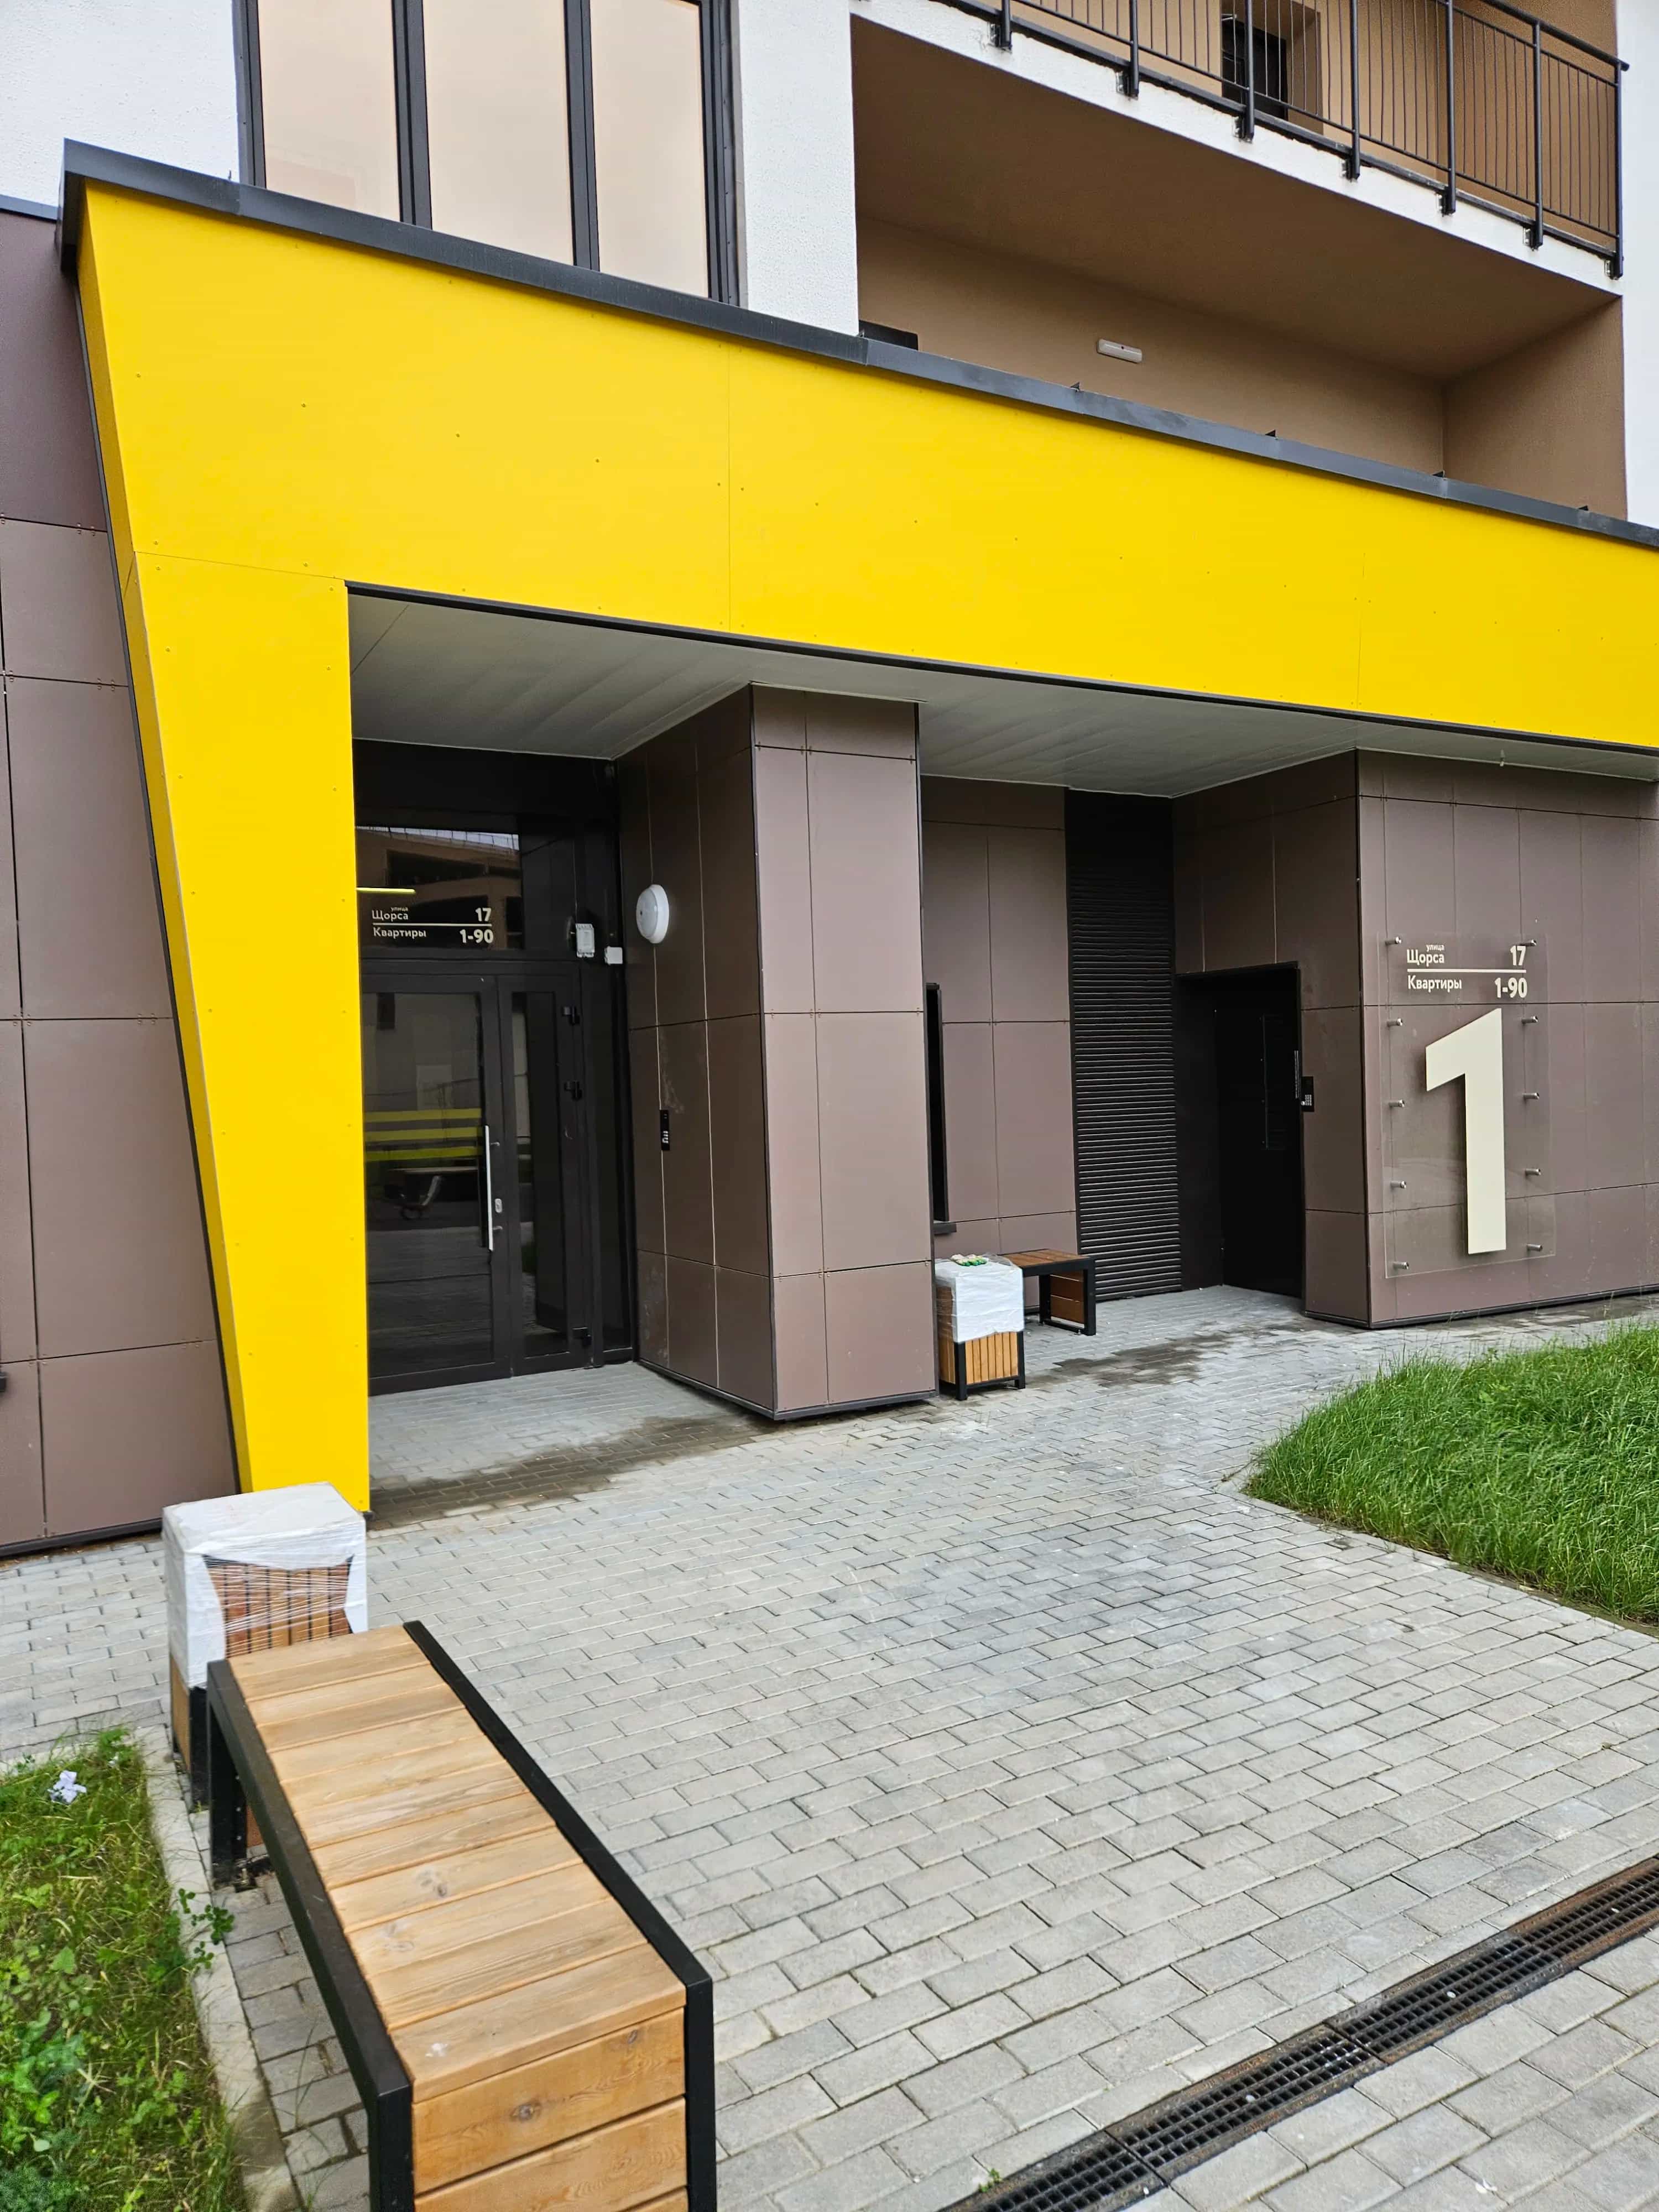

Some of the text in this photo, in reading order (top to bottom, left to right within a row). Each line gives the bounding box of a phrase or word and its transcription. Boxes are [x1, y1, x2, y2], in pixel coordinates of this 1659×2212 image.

[372, 907, 492, 922] Щорса 17
[373, 927, 493, 943] Квартиры 1-90
[1406, 946, 1526, 967] Щорса 17
[1408, 975, 1527, 998] Квартиры 1-90
[1426, 1008, 1506, 1254] 1
